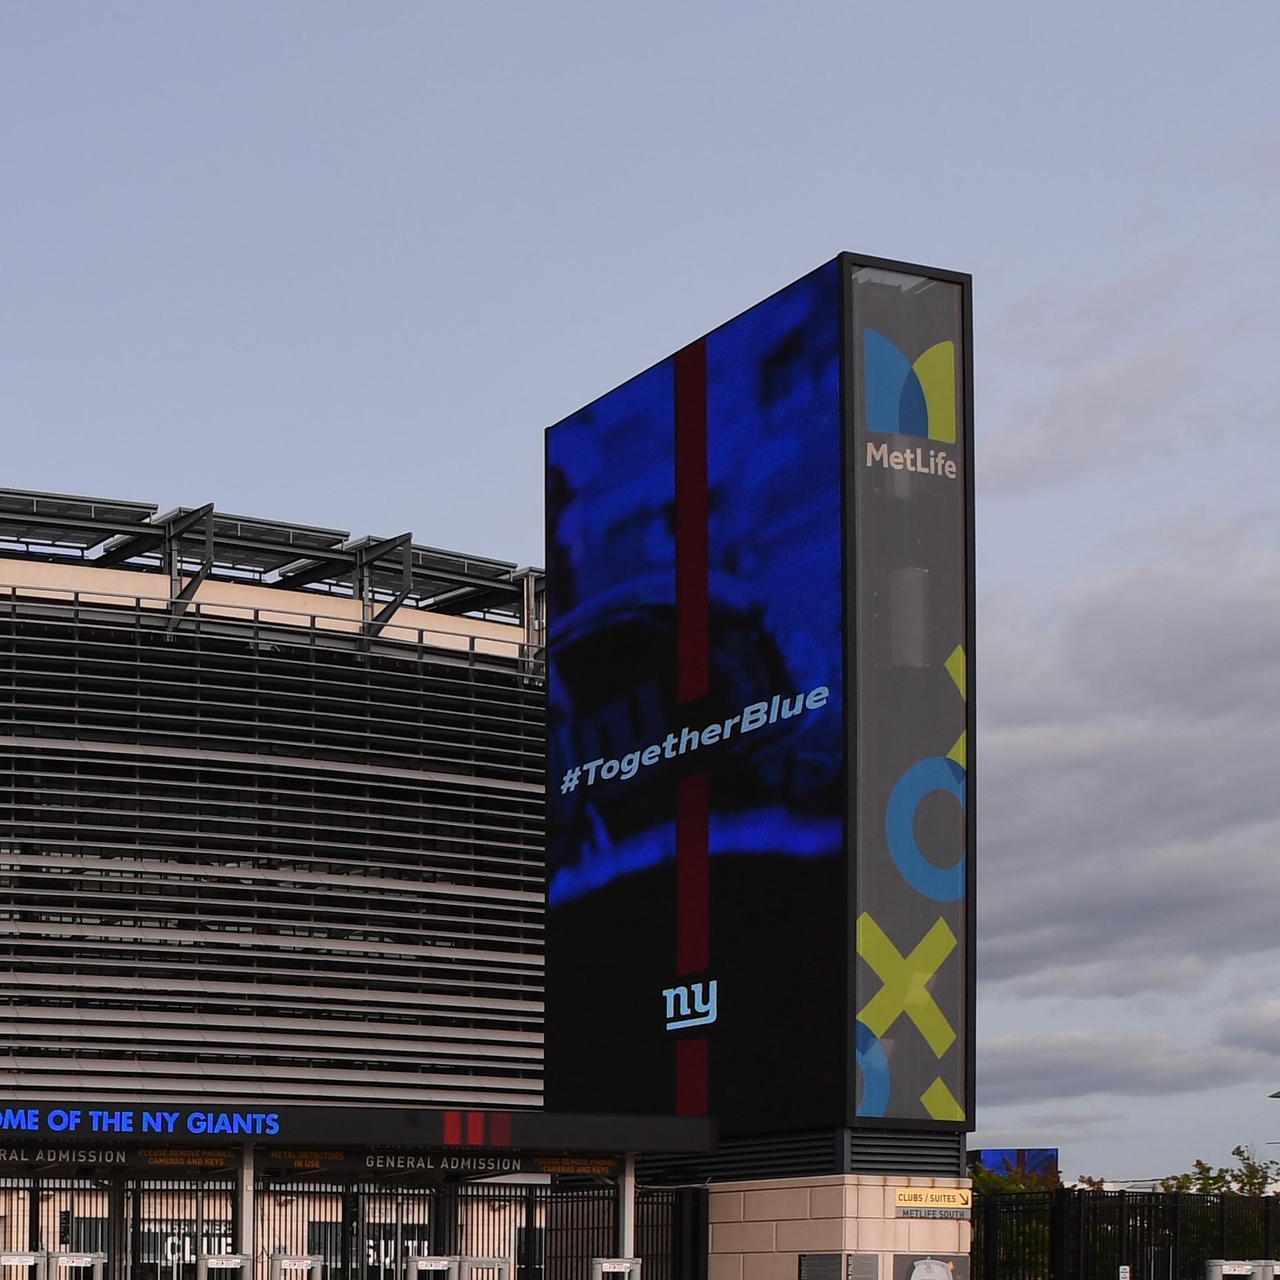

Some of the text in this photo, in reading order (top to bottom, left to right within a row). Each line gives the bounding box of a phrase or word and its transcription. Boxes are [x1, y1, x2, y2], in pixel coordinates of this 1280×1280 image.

[866, 443, 956, 479] MetLife
[560, 686, 829, 795] #TogetherBlue
[47, 1109, 82, 1132] OF
[89, 1110, 134, 1133] THE
[142, 1111, 180, 1133] NY
[186, 1112, 280, 1135] GIANTS
[35, 1149, 126, 1162] ADMISSION
[149, 1157, 184, 1165] CAMERAS
[204, 1158, 224, 1166] KEYS
[304, 1160, 320, 1168] USE
[365, 1155, 522, 1171] GENERAL ADMISSION
[576, 1166, 591, 1174] AND
[898, 1194, 923, 1202] CLUBS
[930, 1194, 956, 1203] SUITES
[902, 1209, 965, 1219] METLIFE SOUTH
